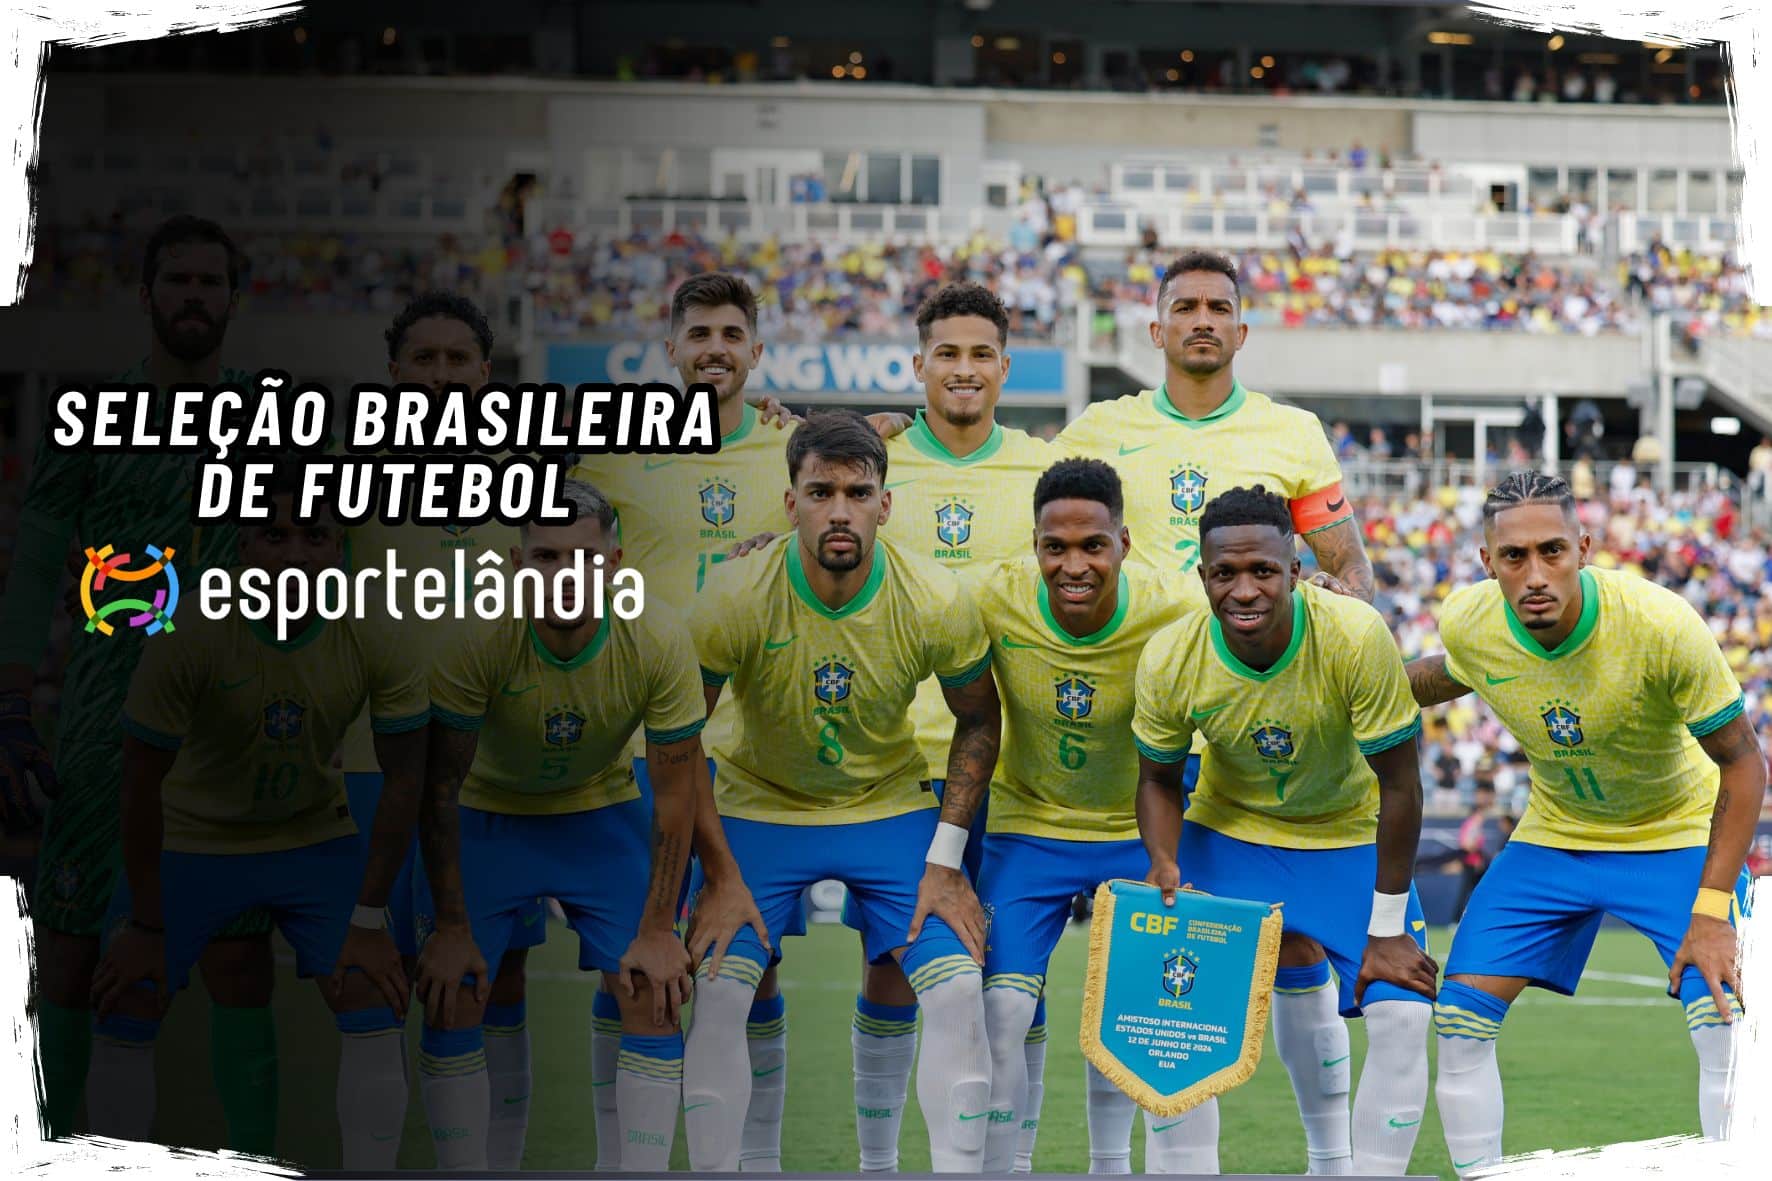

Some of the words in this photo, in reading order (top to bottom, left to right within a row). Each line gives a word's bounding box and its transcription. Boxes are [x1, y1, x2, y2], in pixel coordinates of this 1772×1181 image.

[699, 528, 737, 540] BRASIL
[934, 548, 973, 560] BRASIL
[816, 721, 844, 766] 8
[1059, 733, 1088, 771] 6
[1553, 748, 1595, 758] BRASIL
[1269, 768, 1292, 802] 7
[1562, 767, 1606, 801] 11
[1129, 911, 1179, 936] CBF
[1158, 998, 1193, 1010] BRASIL
[1117, 1014, 1160, 1026] AMISTOSO
[1161, 1019, 1229, 1034] INTERNACIONAL
[1115, 1024, 1153, 1035] ESTADOS
[1154, 1029, 1186, 1039] UNIDOS
[1198, 1034, 1227, 1045] BRASIL
[1127, 1036, 1137, 1044] 12
[1138, 1037, 1150, 1045] DE
[1151, 1038, 1179, 1049] JUNHO
[1180, 1042, 1192, 1050] DE
[1192, 1043, 1212, 1053] 2024
[1148, 1048, 1189, 1061] ORLANDO
[1158, 1060, 1176, 1069] EUA
